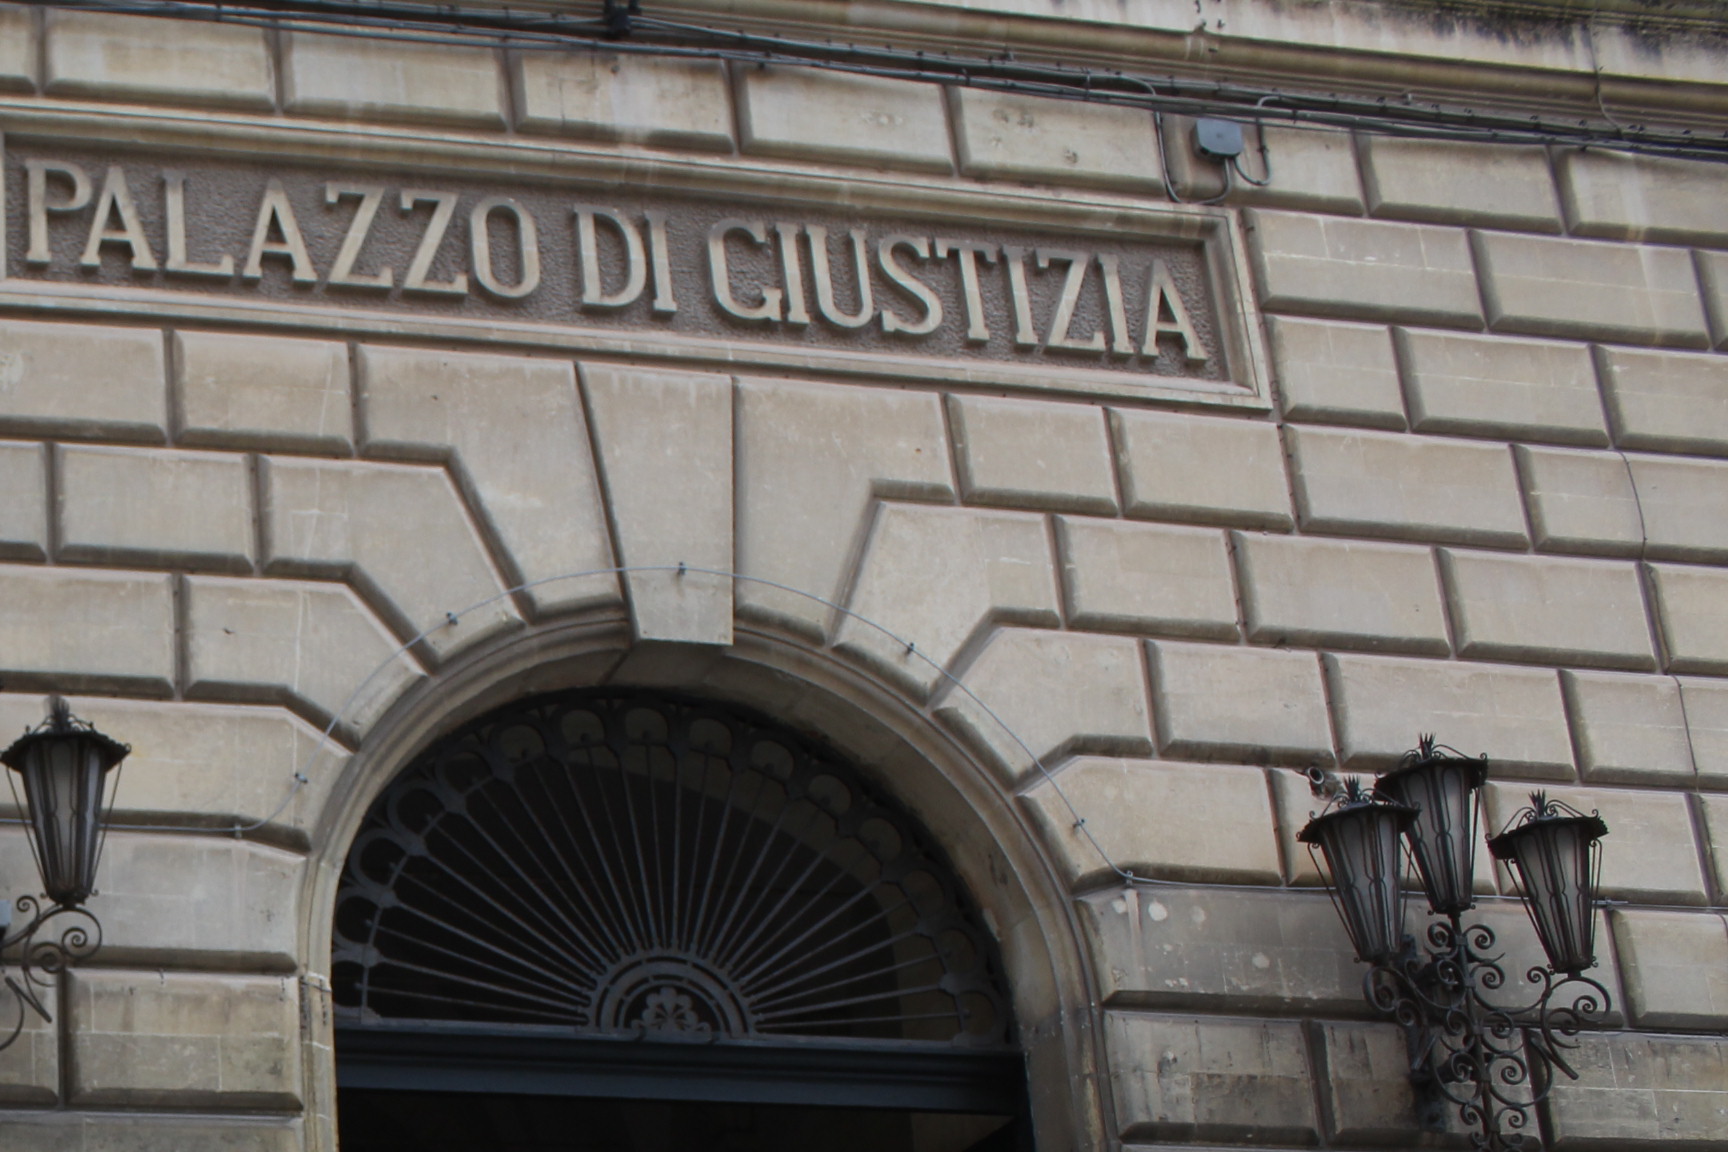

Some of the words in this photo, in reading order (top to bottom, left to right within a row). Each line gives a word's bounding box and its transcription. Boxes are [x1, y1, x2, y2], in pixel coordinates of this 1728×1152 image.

[24, 158, 541, 299] PALAZZO
[573, 206, 677, 312] DI
[707, 216, 1209, 362] GIUSTIZIA
